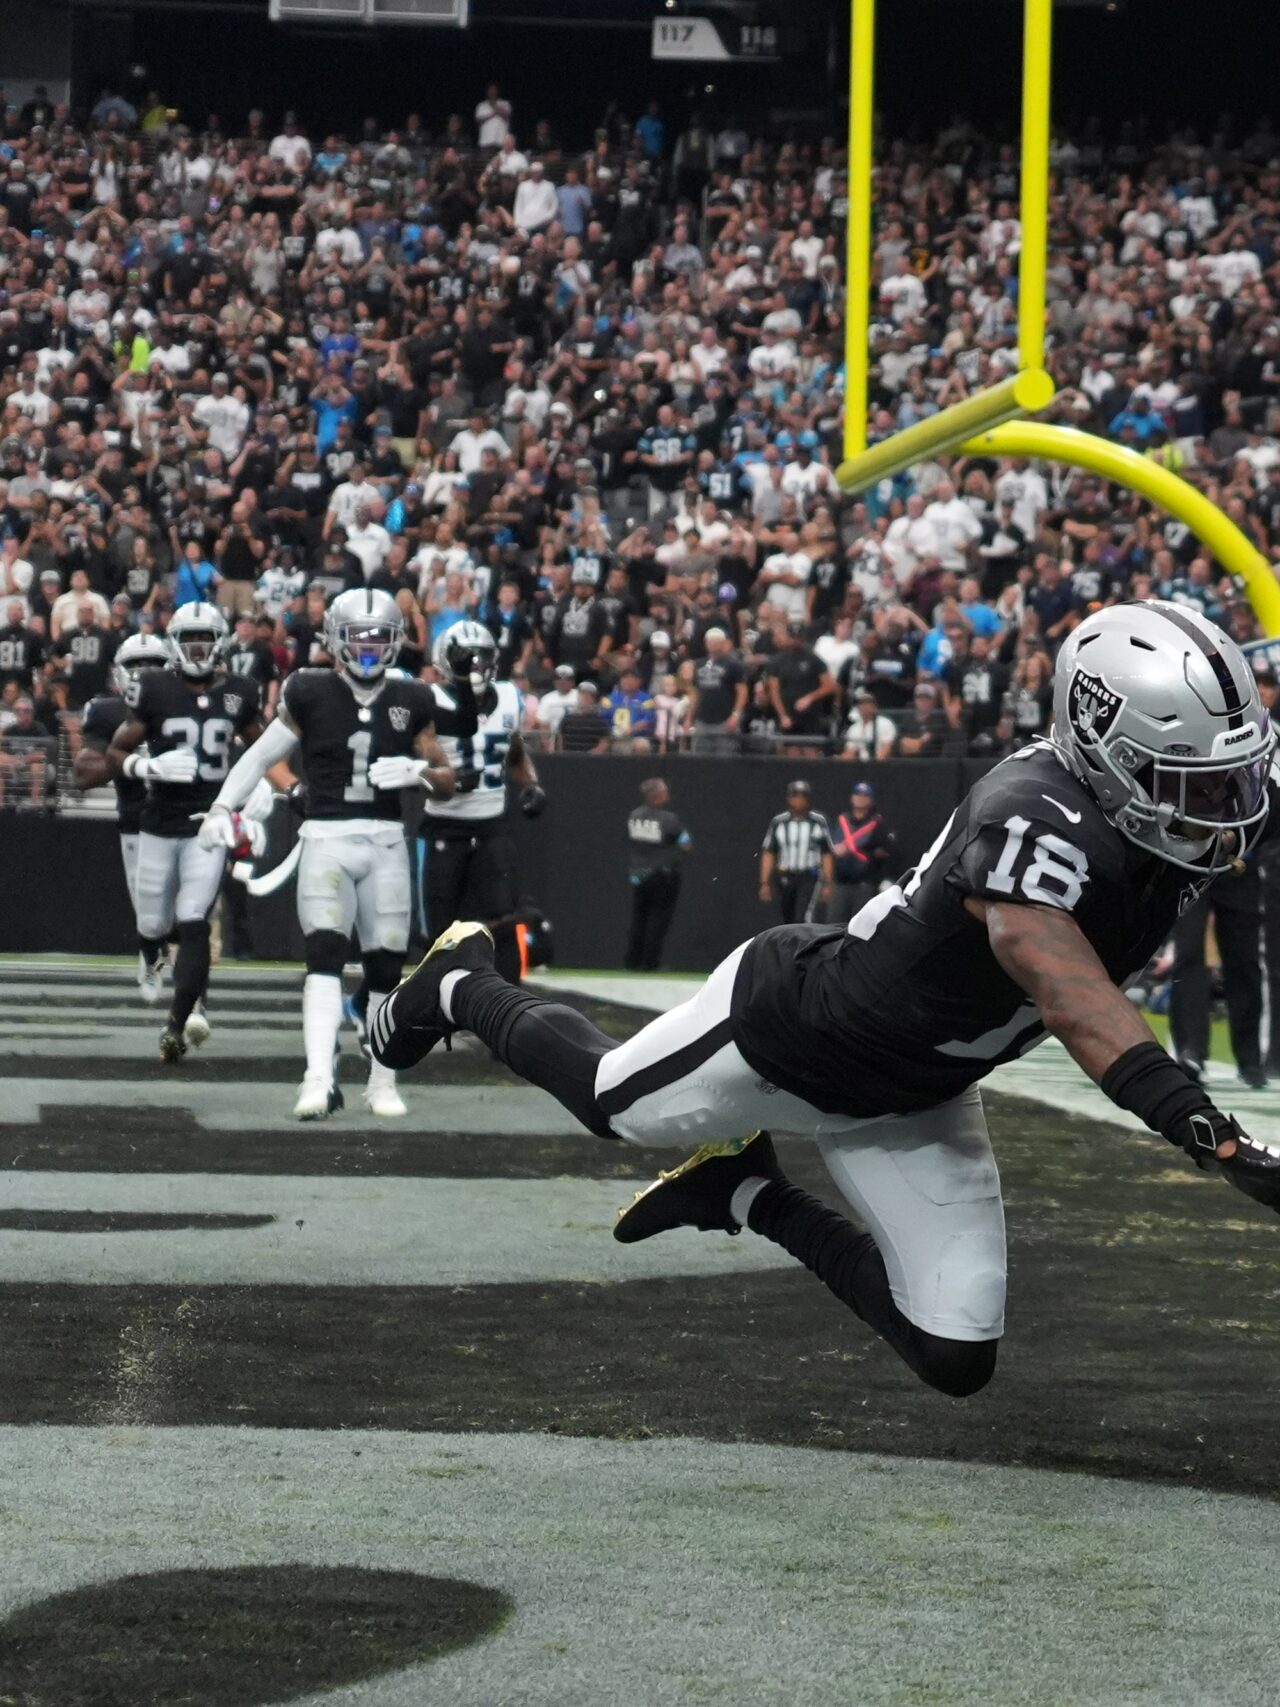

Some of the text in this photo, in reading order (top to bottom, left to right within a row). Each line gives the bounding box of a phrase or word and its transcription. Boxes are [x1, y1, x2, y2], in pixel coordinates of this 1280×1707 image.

[661, 25, 695, 42] 117
[71, 637, 99, 664] 98
[231, 651, 256, 678] 17
[1077, 671, 1117, 705] RAIDERS
[1224, 729, 1254, 747] RAIDERS
[344, 730, 376, 803] 1
[985, 814, 1090, 911] 18
